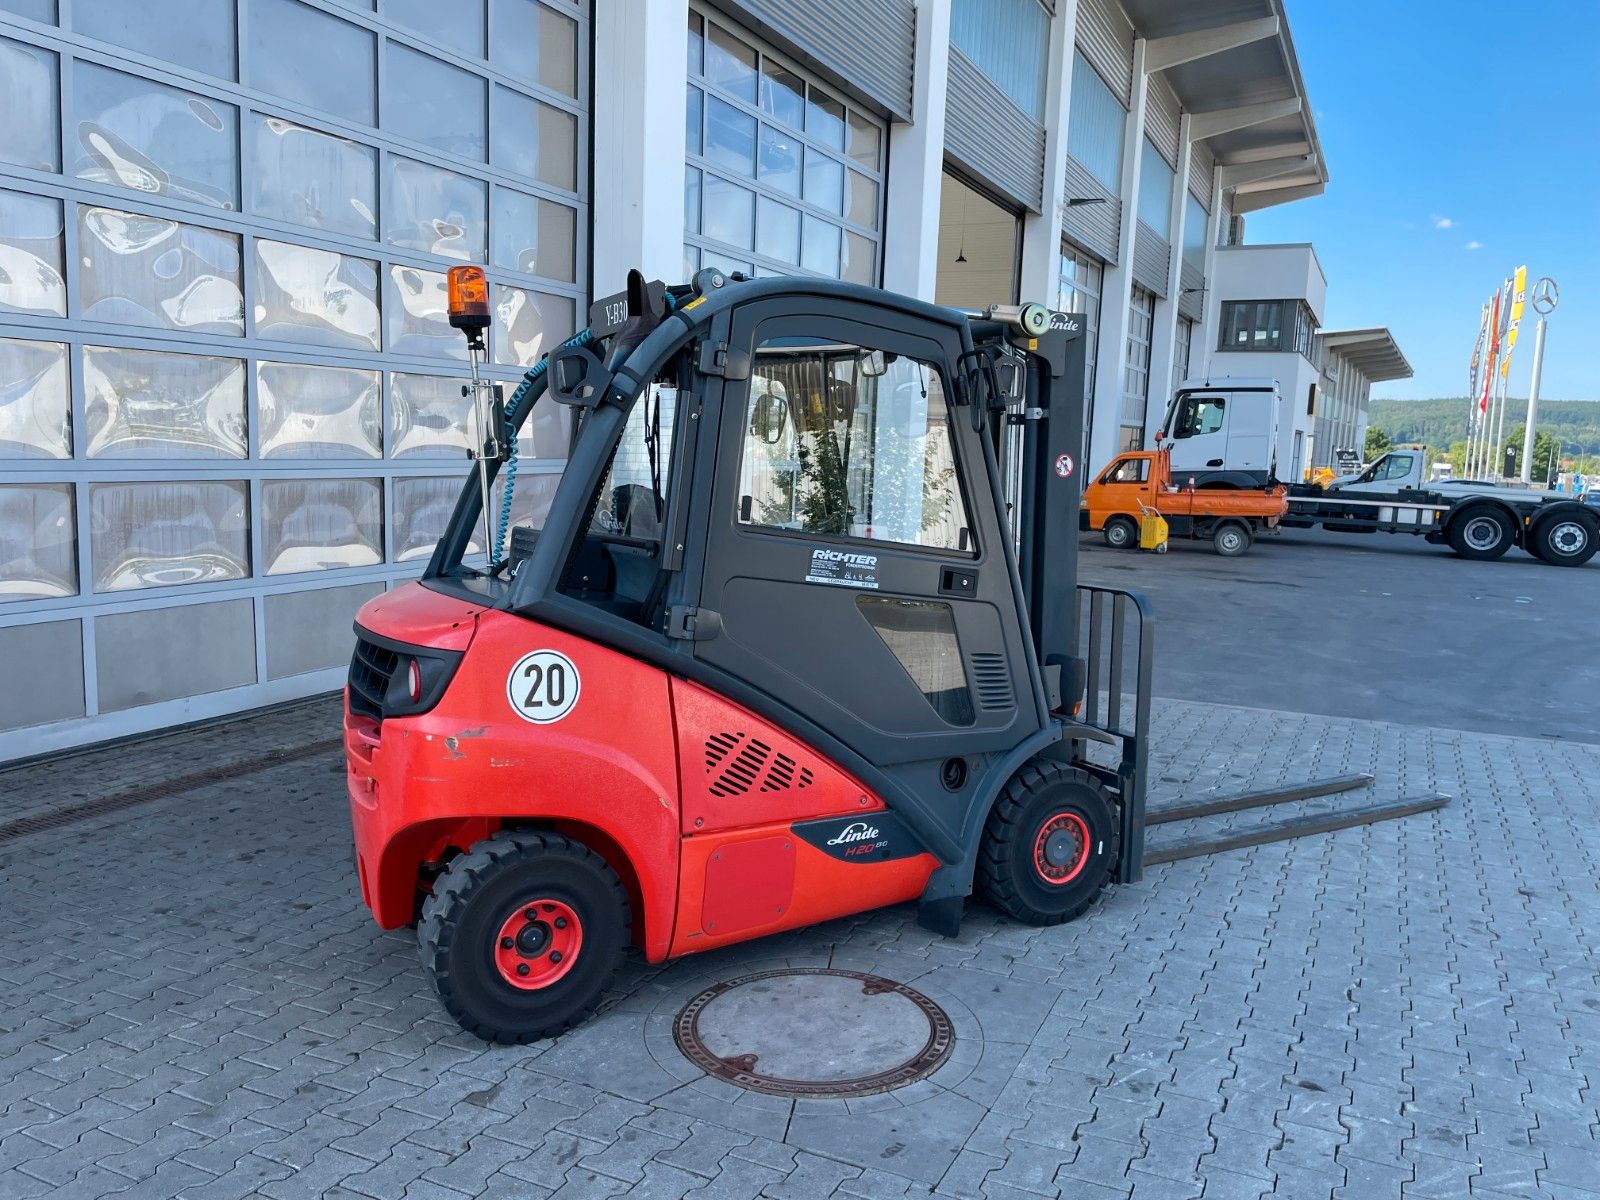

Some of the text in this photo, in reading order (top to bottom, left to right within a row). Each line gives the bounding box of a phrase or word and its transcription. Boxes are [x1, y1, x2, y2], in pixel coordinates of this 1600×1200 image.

[605, 300, 629, 326] Y-B30
[524, 663, 565, 708] 20
[826, 822, 879, 846] Linde
[845, 843, 875, 857] H20
